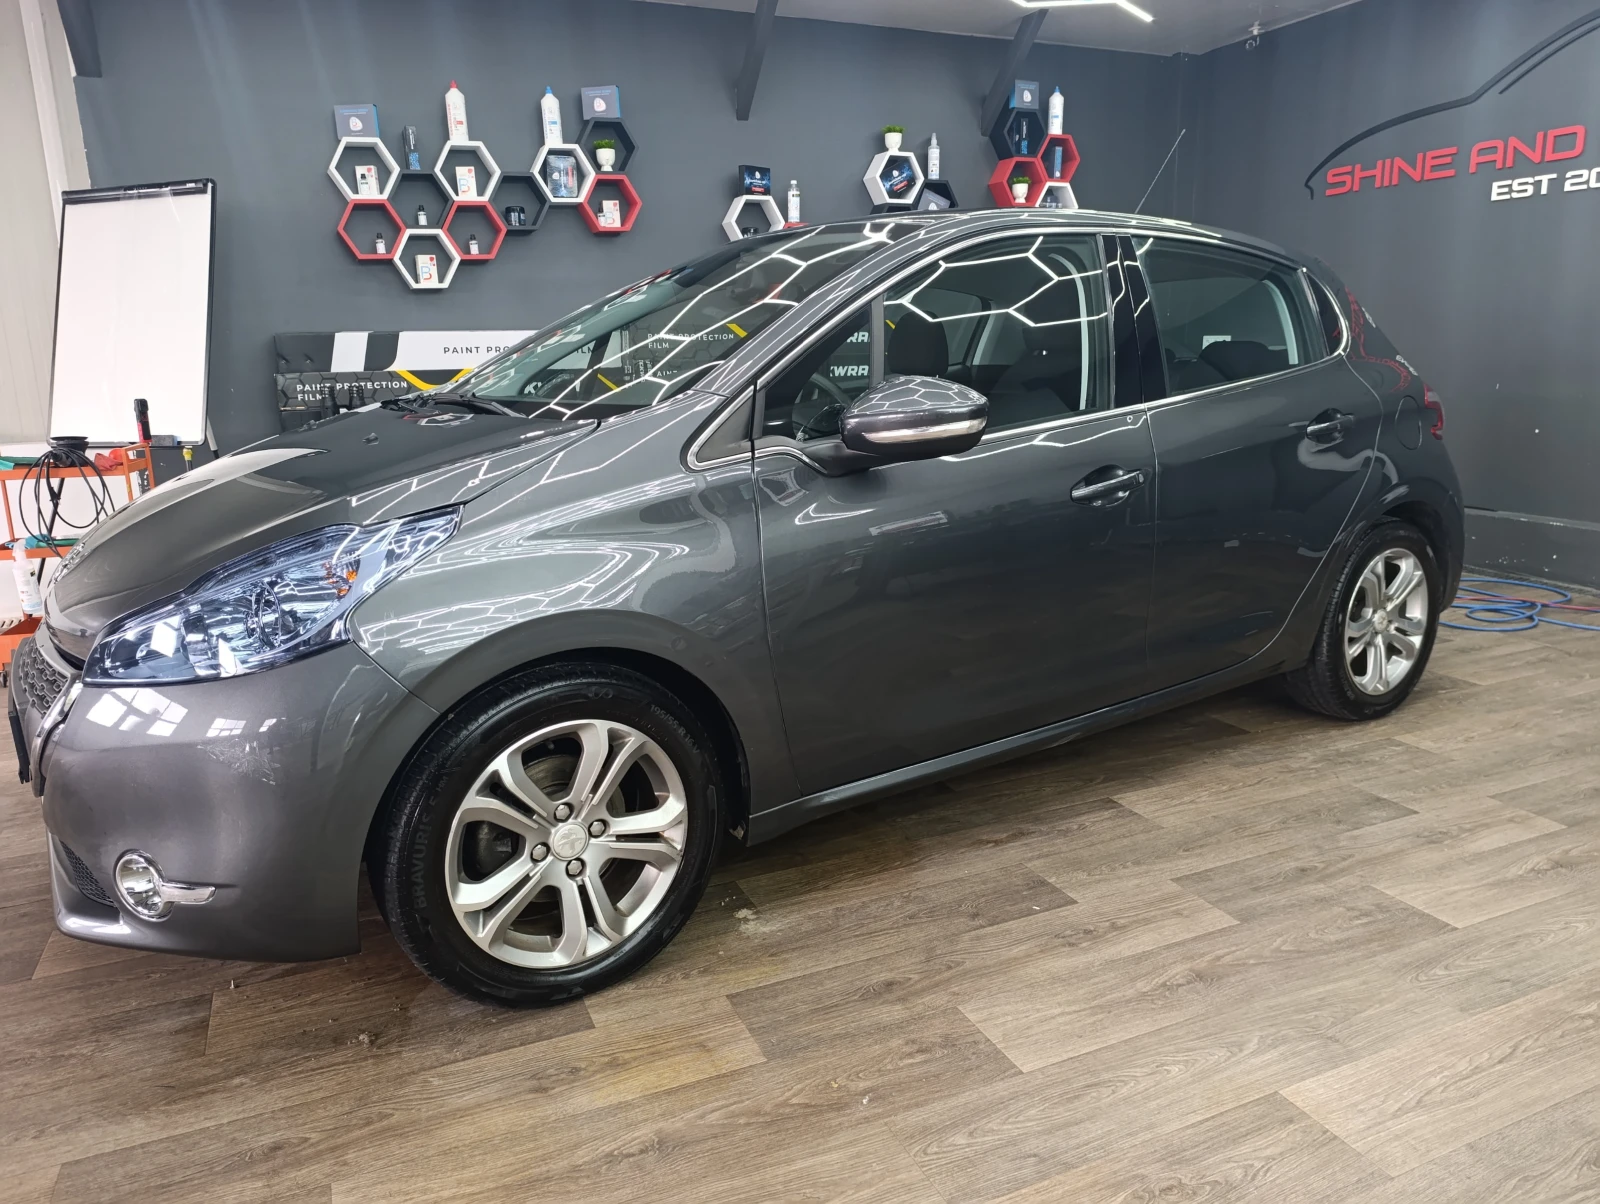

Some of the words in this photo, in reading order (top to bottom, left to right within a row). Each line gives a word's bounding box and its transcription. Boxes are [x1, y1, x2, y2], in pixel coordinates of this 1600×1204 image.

[1325, 146, 1459, 197] SHINE
[1468, 124, 1586, 174] AND
[1490, 173, 1557, 202] EST
[443, 346, 480, 355] PAINT
[336, 380, 408, 391] PROTECTION
